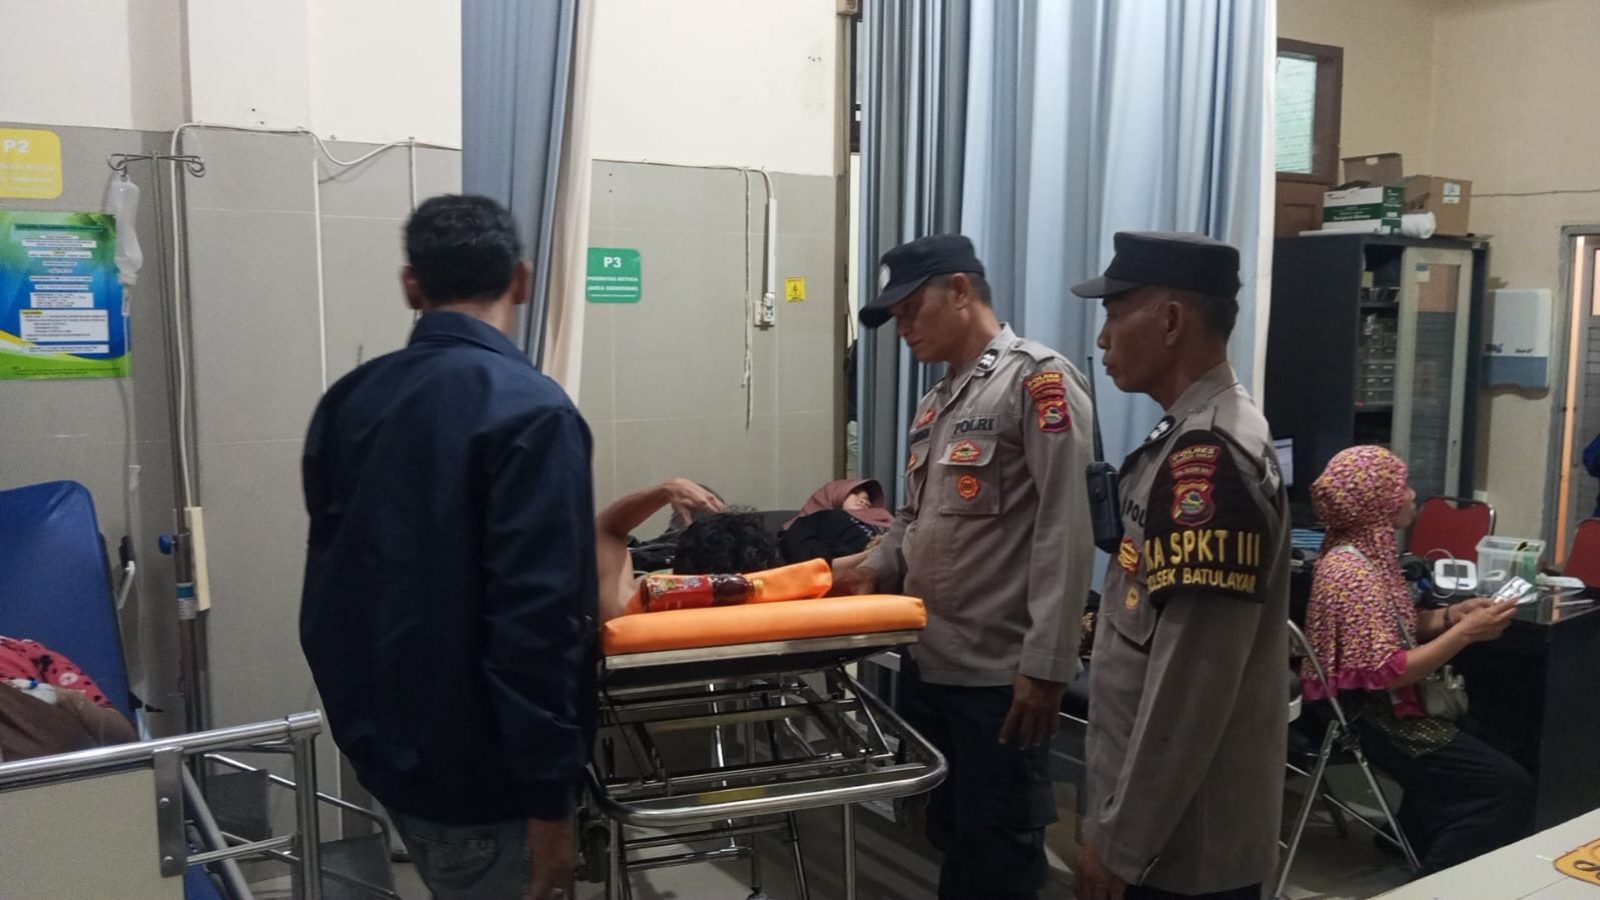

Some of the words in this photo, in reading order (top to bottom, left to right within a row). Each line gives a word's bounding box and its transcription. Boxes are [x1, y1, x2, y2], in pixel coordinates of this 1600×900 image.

[603, 256, 621, 268] P3
[953, 418, 994, 435] POLRI
[1170, 529, 1228, 565] SPKT
[1237, 531, 1260, 567] III
